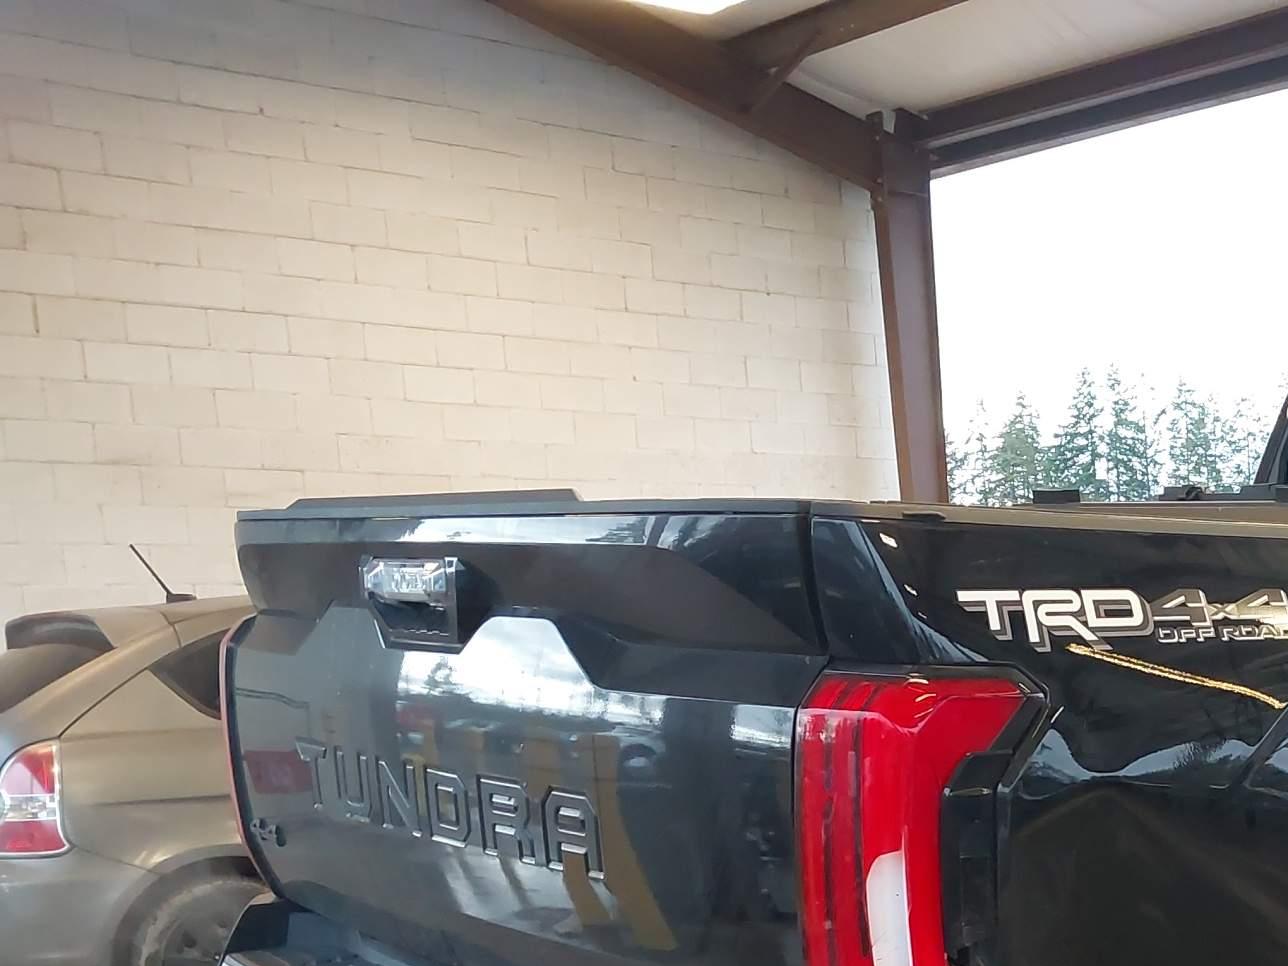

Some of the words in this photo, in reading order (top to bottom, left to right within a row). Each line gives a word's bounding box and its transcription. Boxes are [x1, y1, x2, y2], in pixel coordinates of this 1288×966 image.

[956, 588, 1153, 653] TRD
[1157, 626, 1217, 643] OFF
[295, 736, 605, 880] TUNDRA
